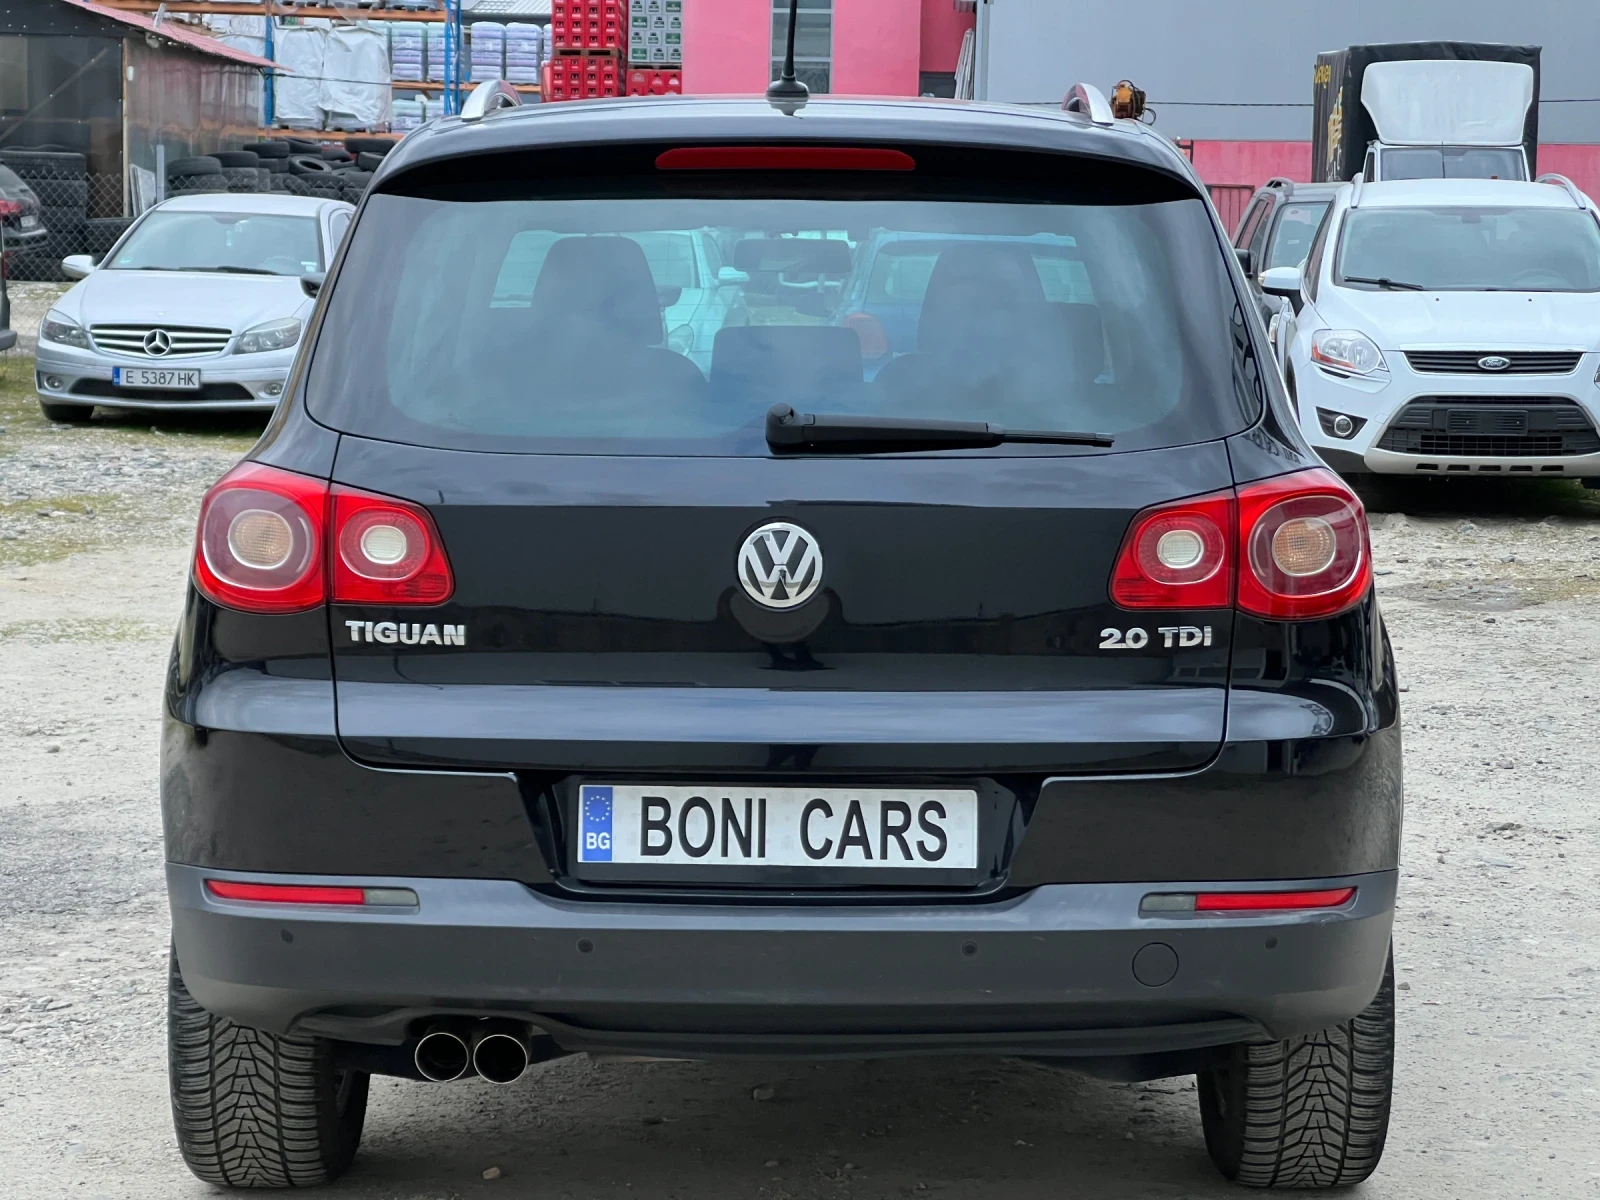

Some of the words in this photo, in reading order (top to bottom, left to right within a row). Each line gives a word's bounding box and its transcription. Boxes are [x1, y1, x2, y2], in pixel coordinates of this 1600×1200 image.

[126, 370, 134, 384] E
[141, 371, 175, 385] 5387
[178, 372, 196, 386] HK
[345, 620, 465, 646] TIGUAN
[1158, 625, 1212, 648] TDI
[640, 796, 767, 858] BONI
[800, 798, 948, 862] CARS
[586, 832, 610, 850] BG
